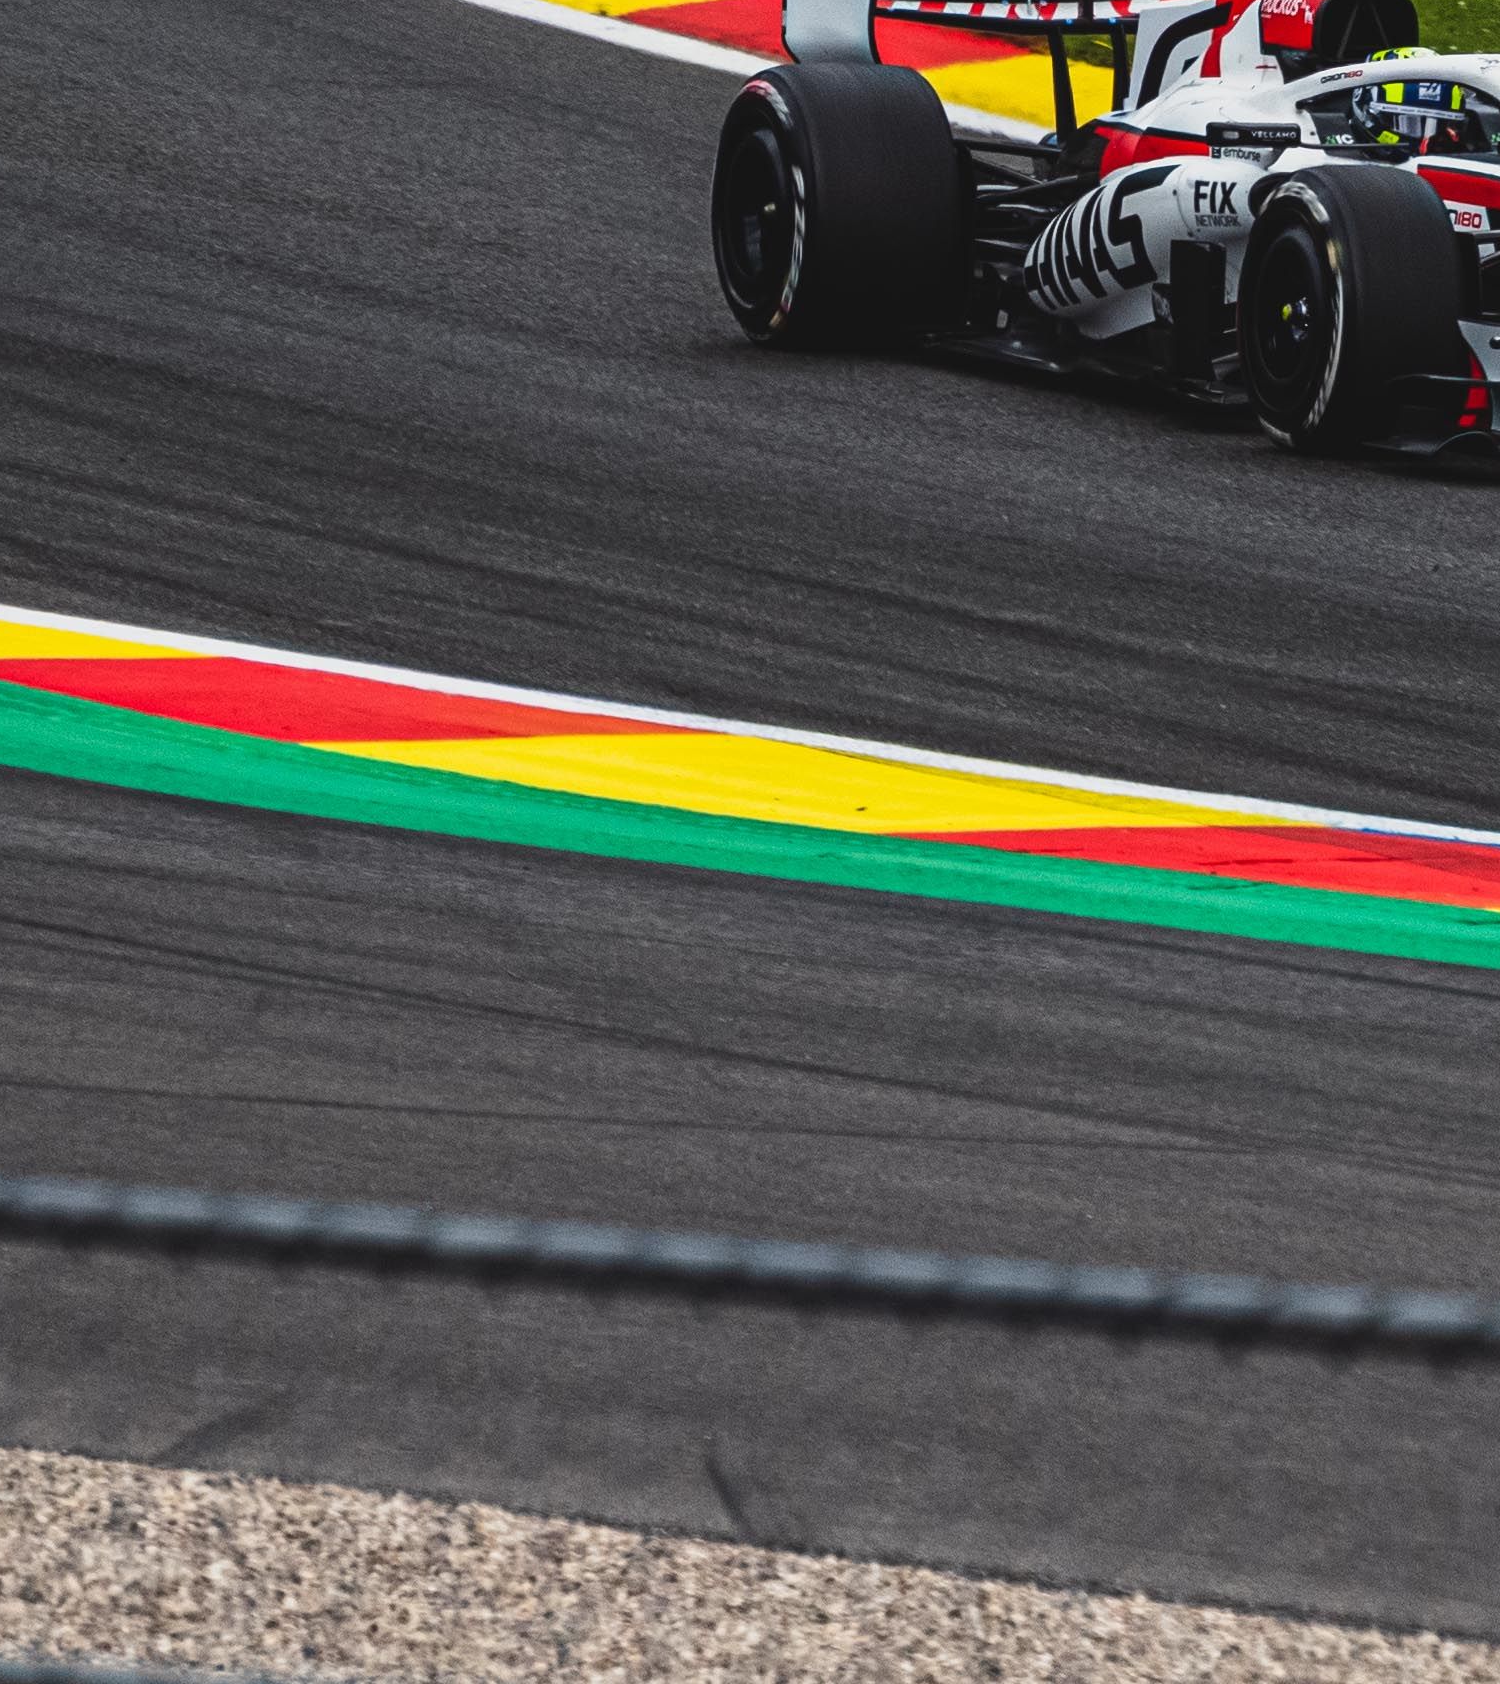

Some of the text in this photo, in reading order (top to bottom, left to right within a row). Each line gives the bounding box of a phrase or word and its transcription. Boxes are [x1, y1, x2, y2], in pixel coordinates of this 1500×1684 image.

[1250, 130, 1298, 139] VELLAMO
[1222, 148, 1261, 162] emburse
[1193, 179, 1238, 214] FIX
[1194, 214, 1242, 227] NETWORK
